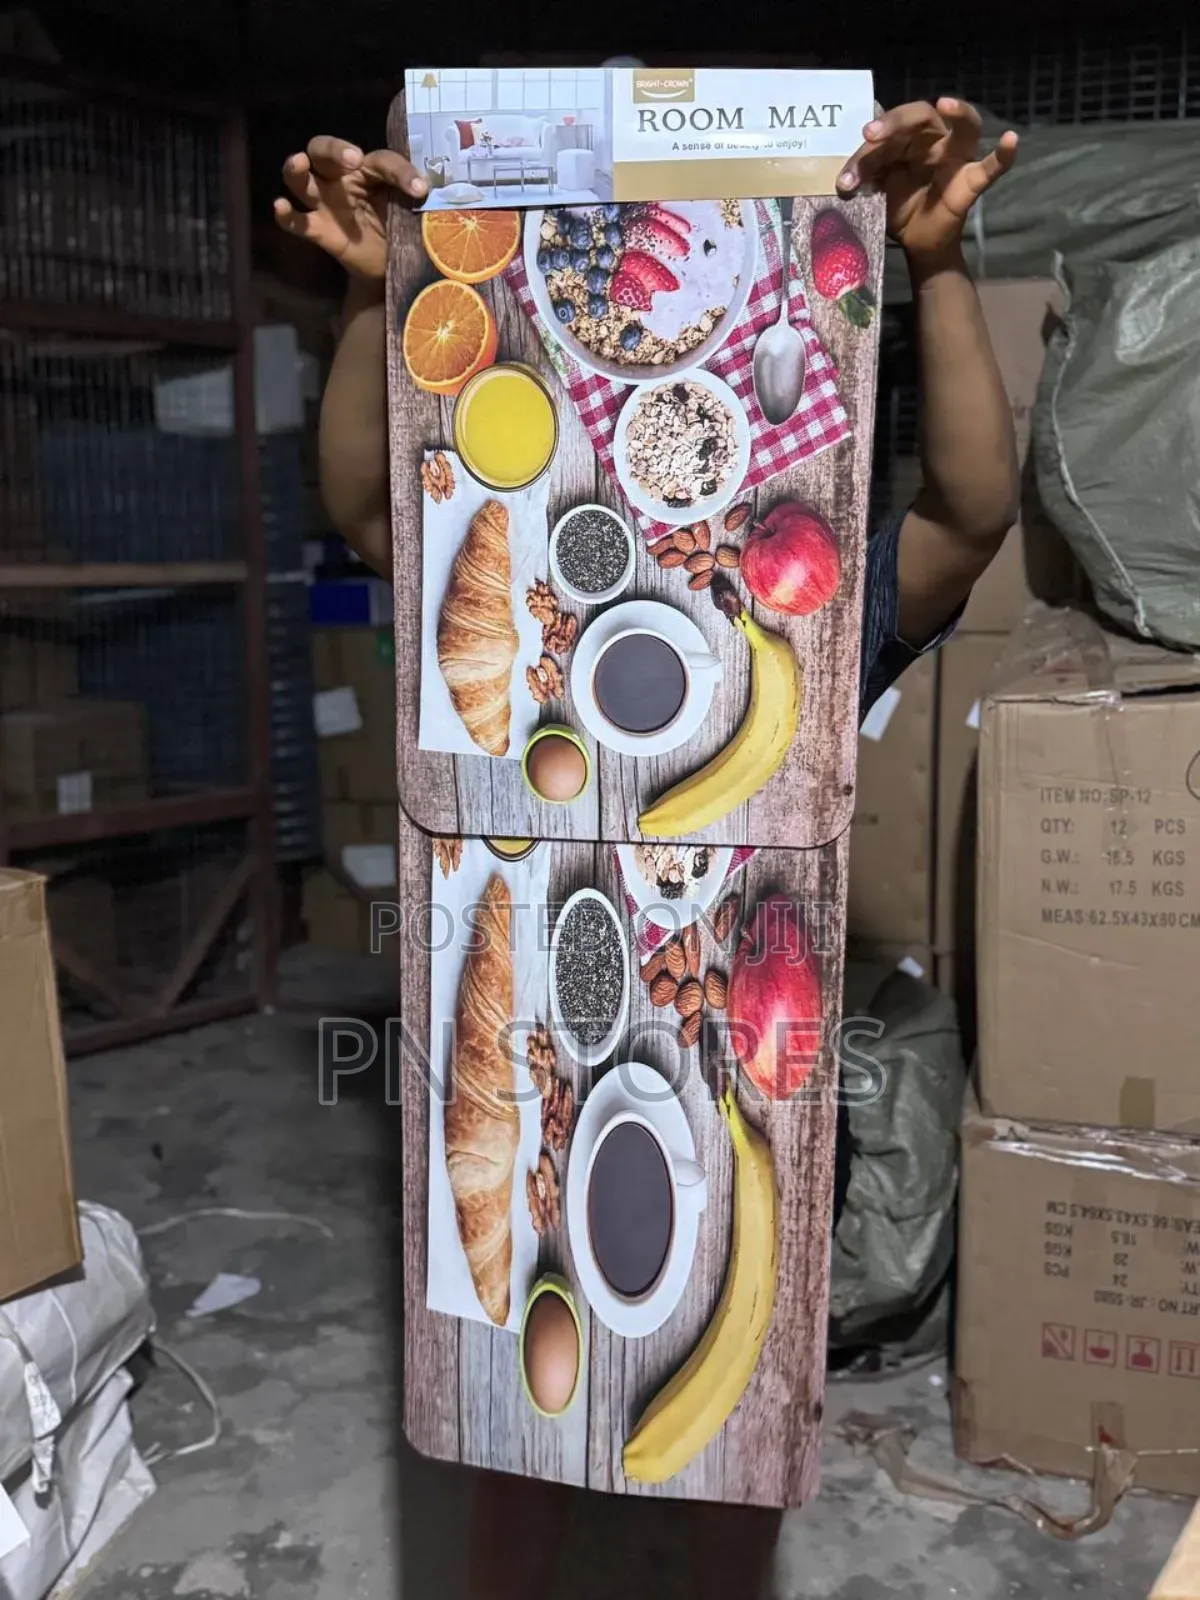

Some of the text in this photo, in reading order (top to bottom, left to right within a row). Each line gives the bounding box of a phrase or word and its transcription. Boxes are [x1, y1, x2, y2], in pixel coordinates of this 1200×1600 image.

[637, 104, 842, 133] ROOM MAT
[672, 141, 680, 150] A
[682, 141, 711, 151] sense
[1040, 787, 1076, 804] ITEM
[1040, 817, 1186, 836] QTY: 12 PCS
[1152, 850, 1186, 867] KGS
[1109, 879, 1137, 896] 17.5
[1151, 880, 1185, 897] KGS
[1046, 1200, 1067, 1215] CM
[1044, 1221, 1073, 1240] KGS
[1044, 1241, 1073, 1259] KGS
[1044, 1261, 1200, 1296] TY: 24 PCS
[1180, 1299, 1200, 1316] RT
